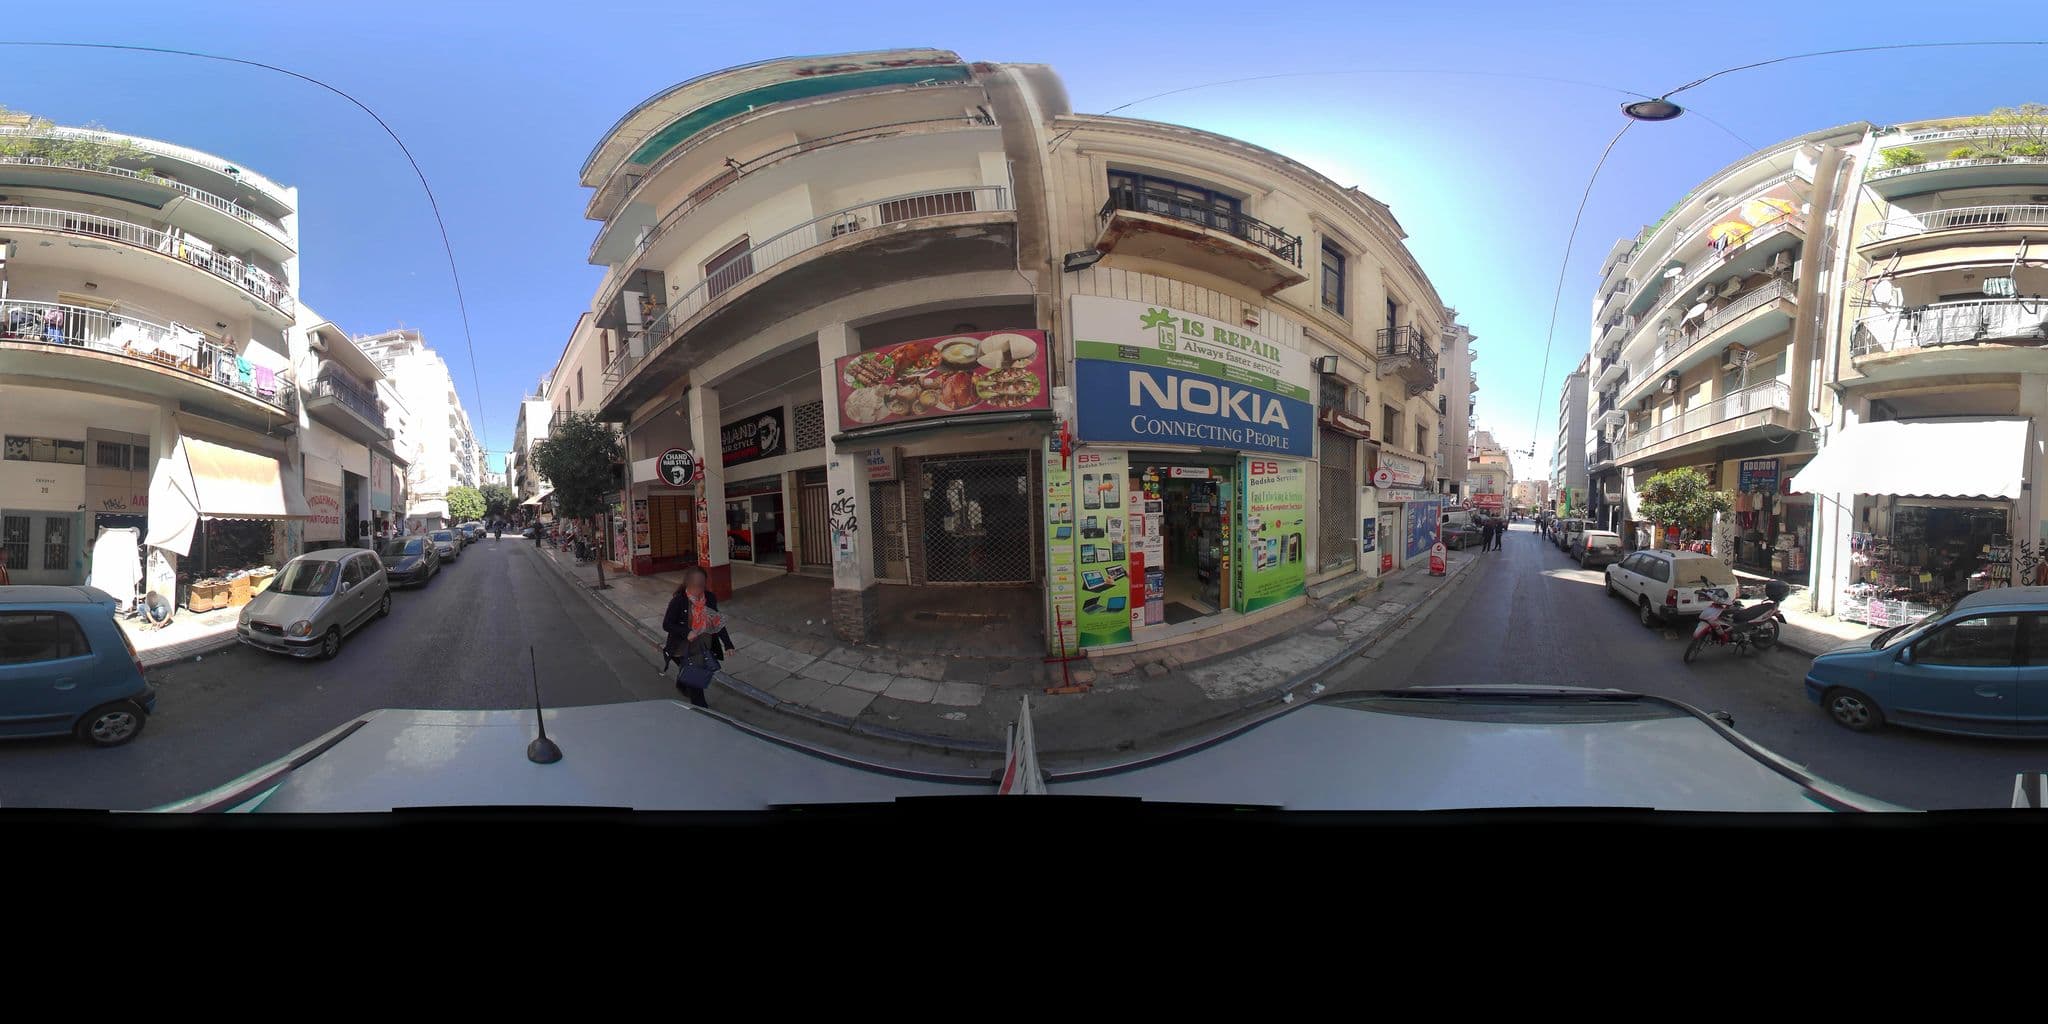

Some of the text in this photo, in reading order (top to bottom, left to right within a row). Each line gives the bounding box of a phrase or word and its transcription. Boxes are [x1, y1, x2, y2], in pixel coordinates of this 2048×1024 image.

[1181, 317, 1204, 338] IS
[1213, 325, 1281, 362] REPAIR
[1183, 340, 1224, 361] Always
[1225, 350, 1252, 369] faster
[1252, 360, 1281, 377] service
[1129, 370, 1289, 430] NOKIA
[721, 423, 757, 445] HAND
[1130, 414, 1289, 449] CONNECTING PEOPLE
[1251, 461, 1279, 475] BS
